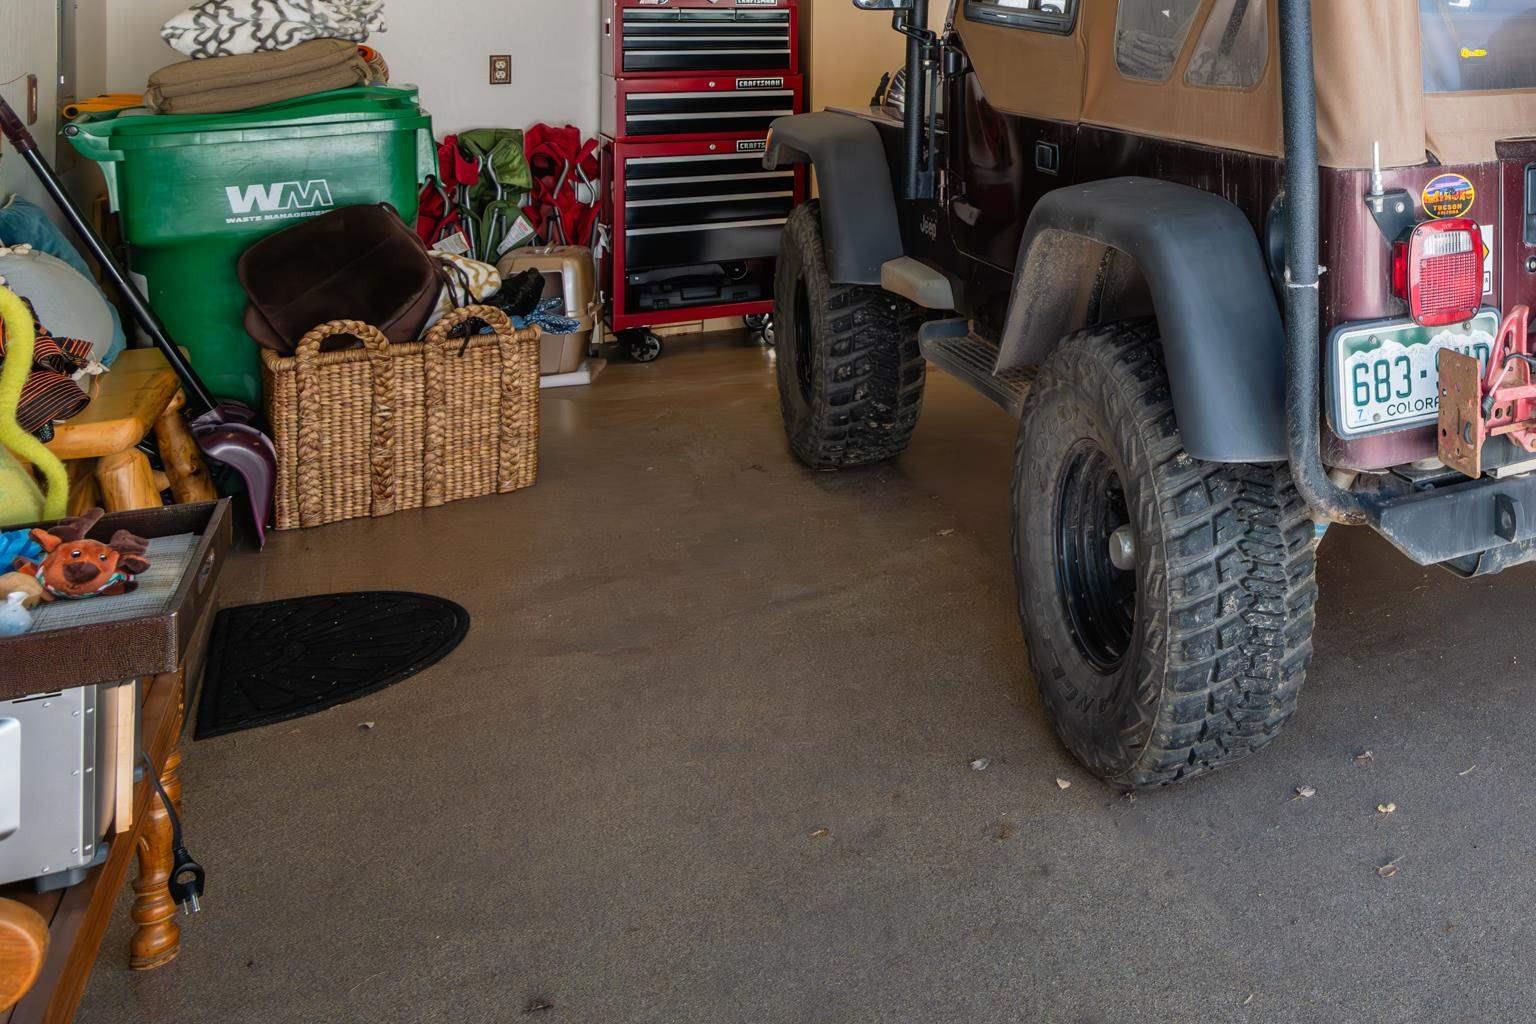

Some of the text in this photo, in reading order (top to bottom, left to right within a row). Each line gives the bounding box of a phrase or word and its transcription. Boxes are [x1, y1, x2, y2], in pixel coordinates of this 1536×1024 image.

[738, 79, 781, 87] CRAFTSMAN
[739, 141, 766, 150] CRAFTS
[225, 179, 334, 213] WM
[1433, 203, 1462, 211] TUCSON
[225, 215, 262, 224] WASTE
[1386, 397, 1440, 416] COLOR
